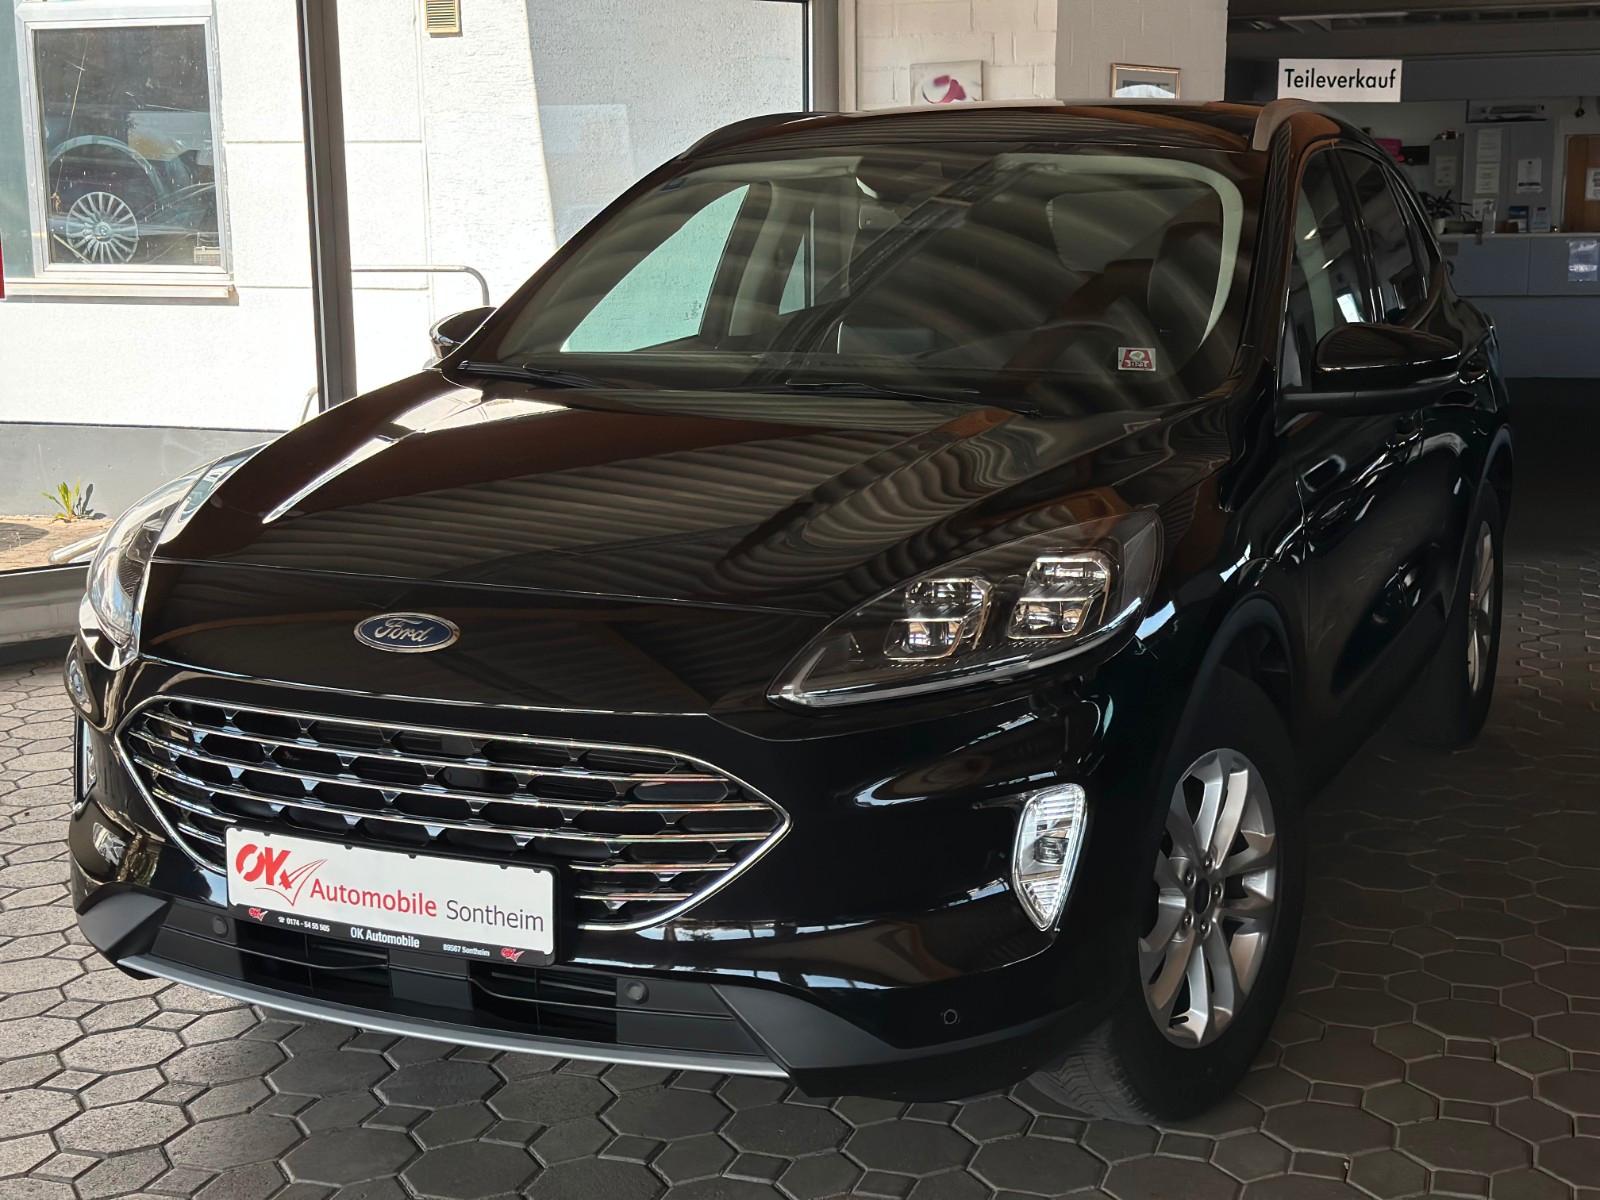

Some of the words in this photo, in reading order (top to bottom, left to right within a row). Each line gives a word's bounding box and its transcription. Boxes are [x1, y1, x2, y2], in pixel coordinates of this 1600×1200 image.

[1284, 67, 1397, 89] Teileverkauf
[374, 618, 434, 642] Ford
[235, 843, 293, 891] OK
[309, 878, 438, 918] Automobile
[446, 899, 545, 933] Sontheim
[350, 926, 365, 940] OK
[365, 929, 420, 948] Automobile
[461, 946, 491, 957] Sontheim
